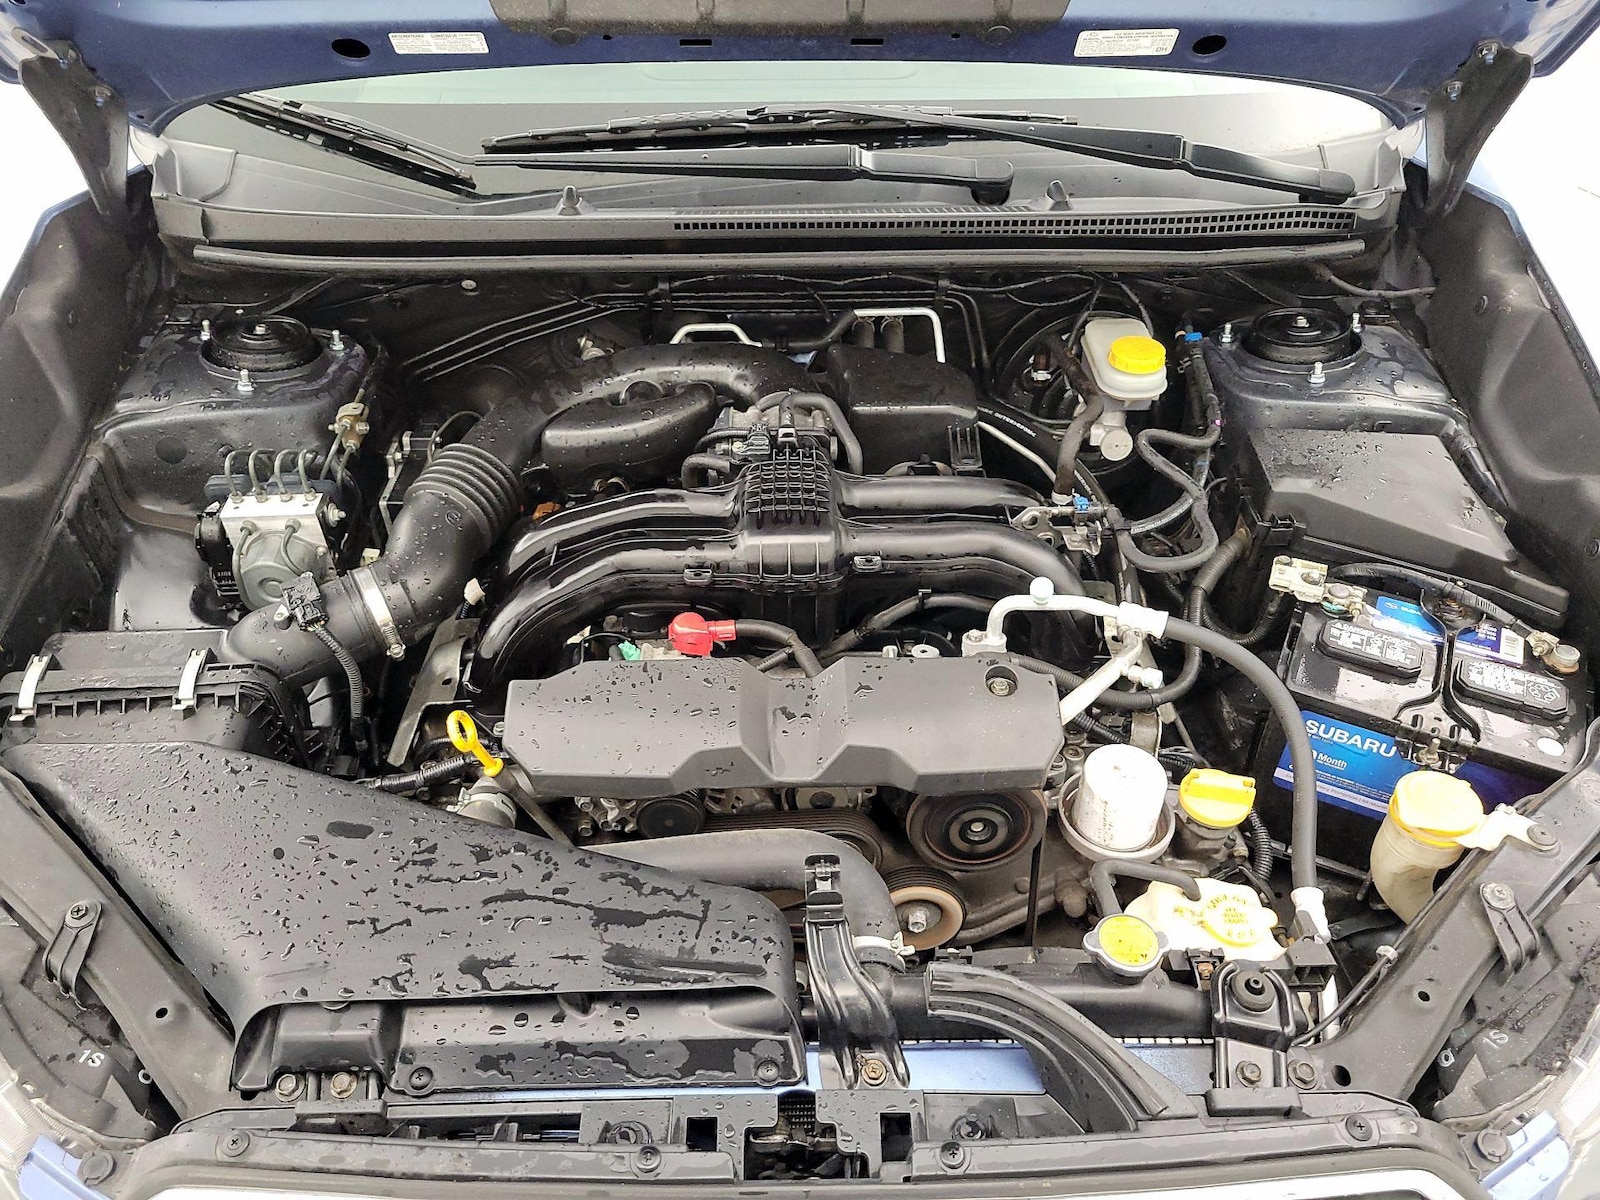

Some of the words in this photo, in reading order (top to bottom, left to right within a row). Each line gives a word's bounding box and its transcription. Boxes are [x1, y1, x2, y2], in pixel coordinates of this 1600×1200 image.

[1305, 719, 1398, 758] SUBARU
[1317, 752, 1348, 769] Month
[78, 1049, 106, 1068] 1S
